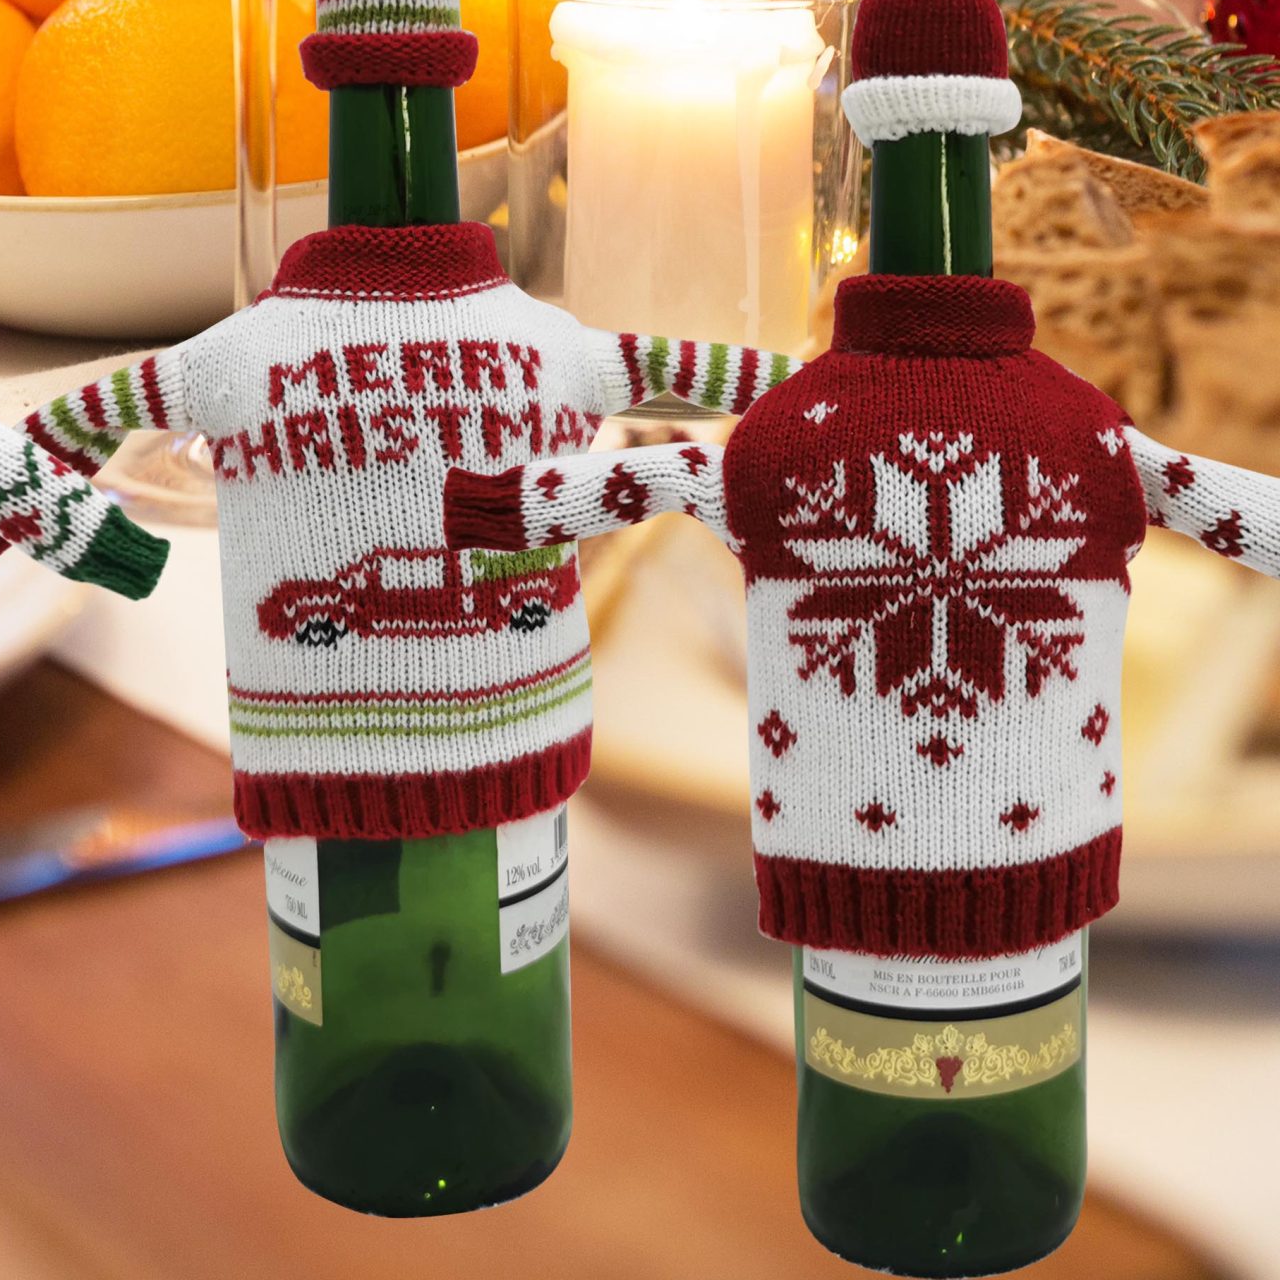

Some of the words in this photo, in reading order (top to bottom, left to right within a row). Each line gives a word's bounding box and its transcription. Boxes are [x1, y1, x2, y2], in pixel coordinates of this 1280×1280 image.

[269, 339, 541, 408] MERRY
[506, 864, 526, 887] 12%
[873, 970, 894, 982] MIS
[897, 973, 914, 984] EN
[917, 972, 987, 985] BOUTEILLE
[990, 967, 1022, 982] POUR
[903, 987, 912, 997] A
